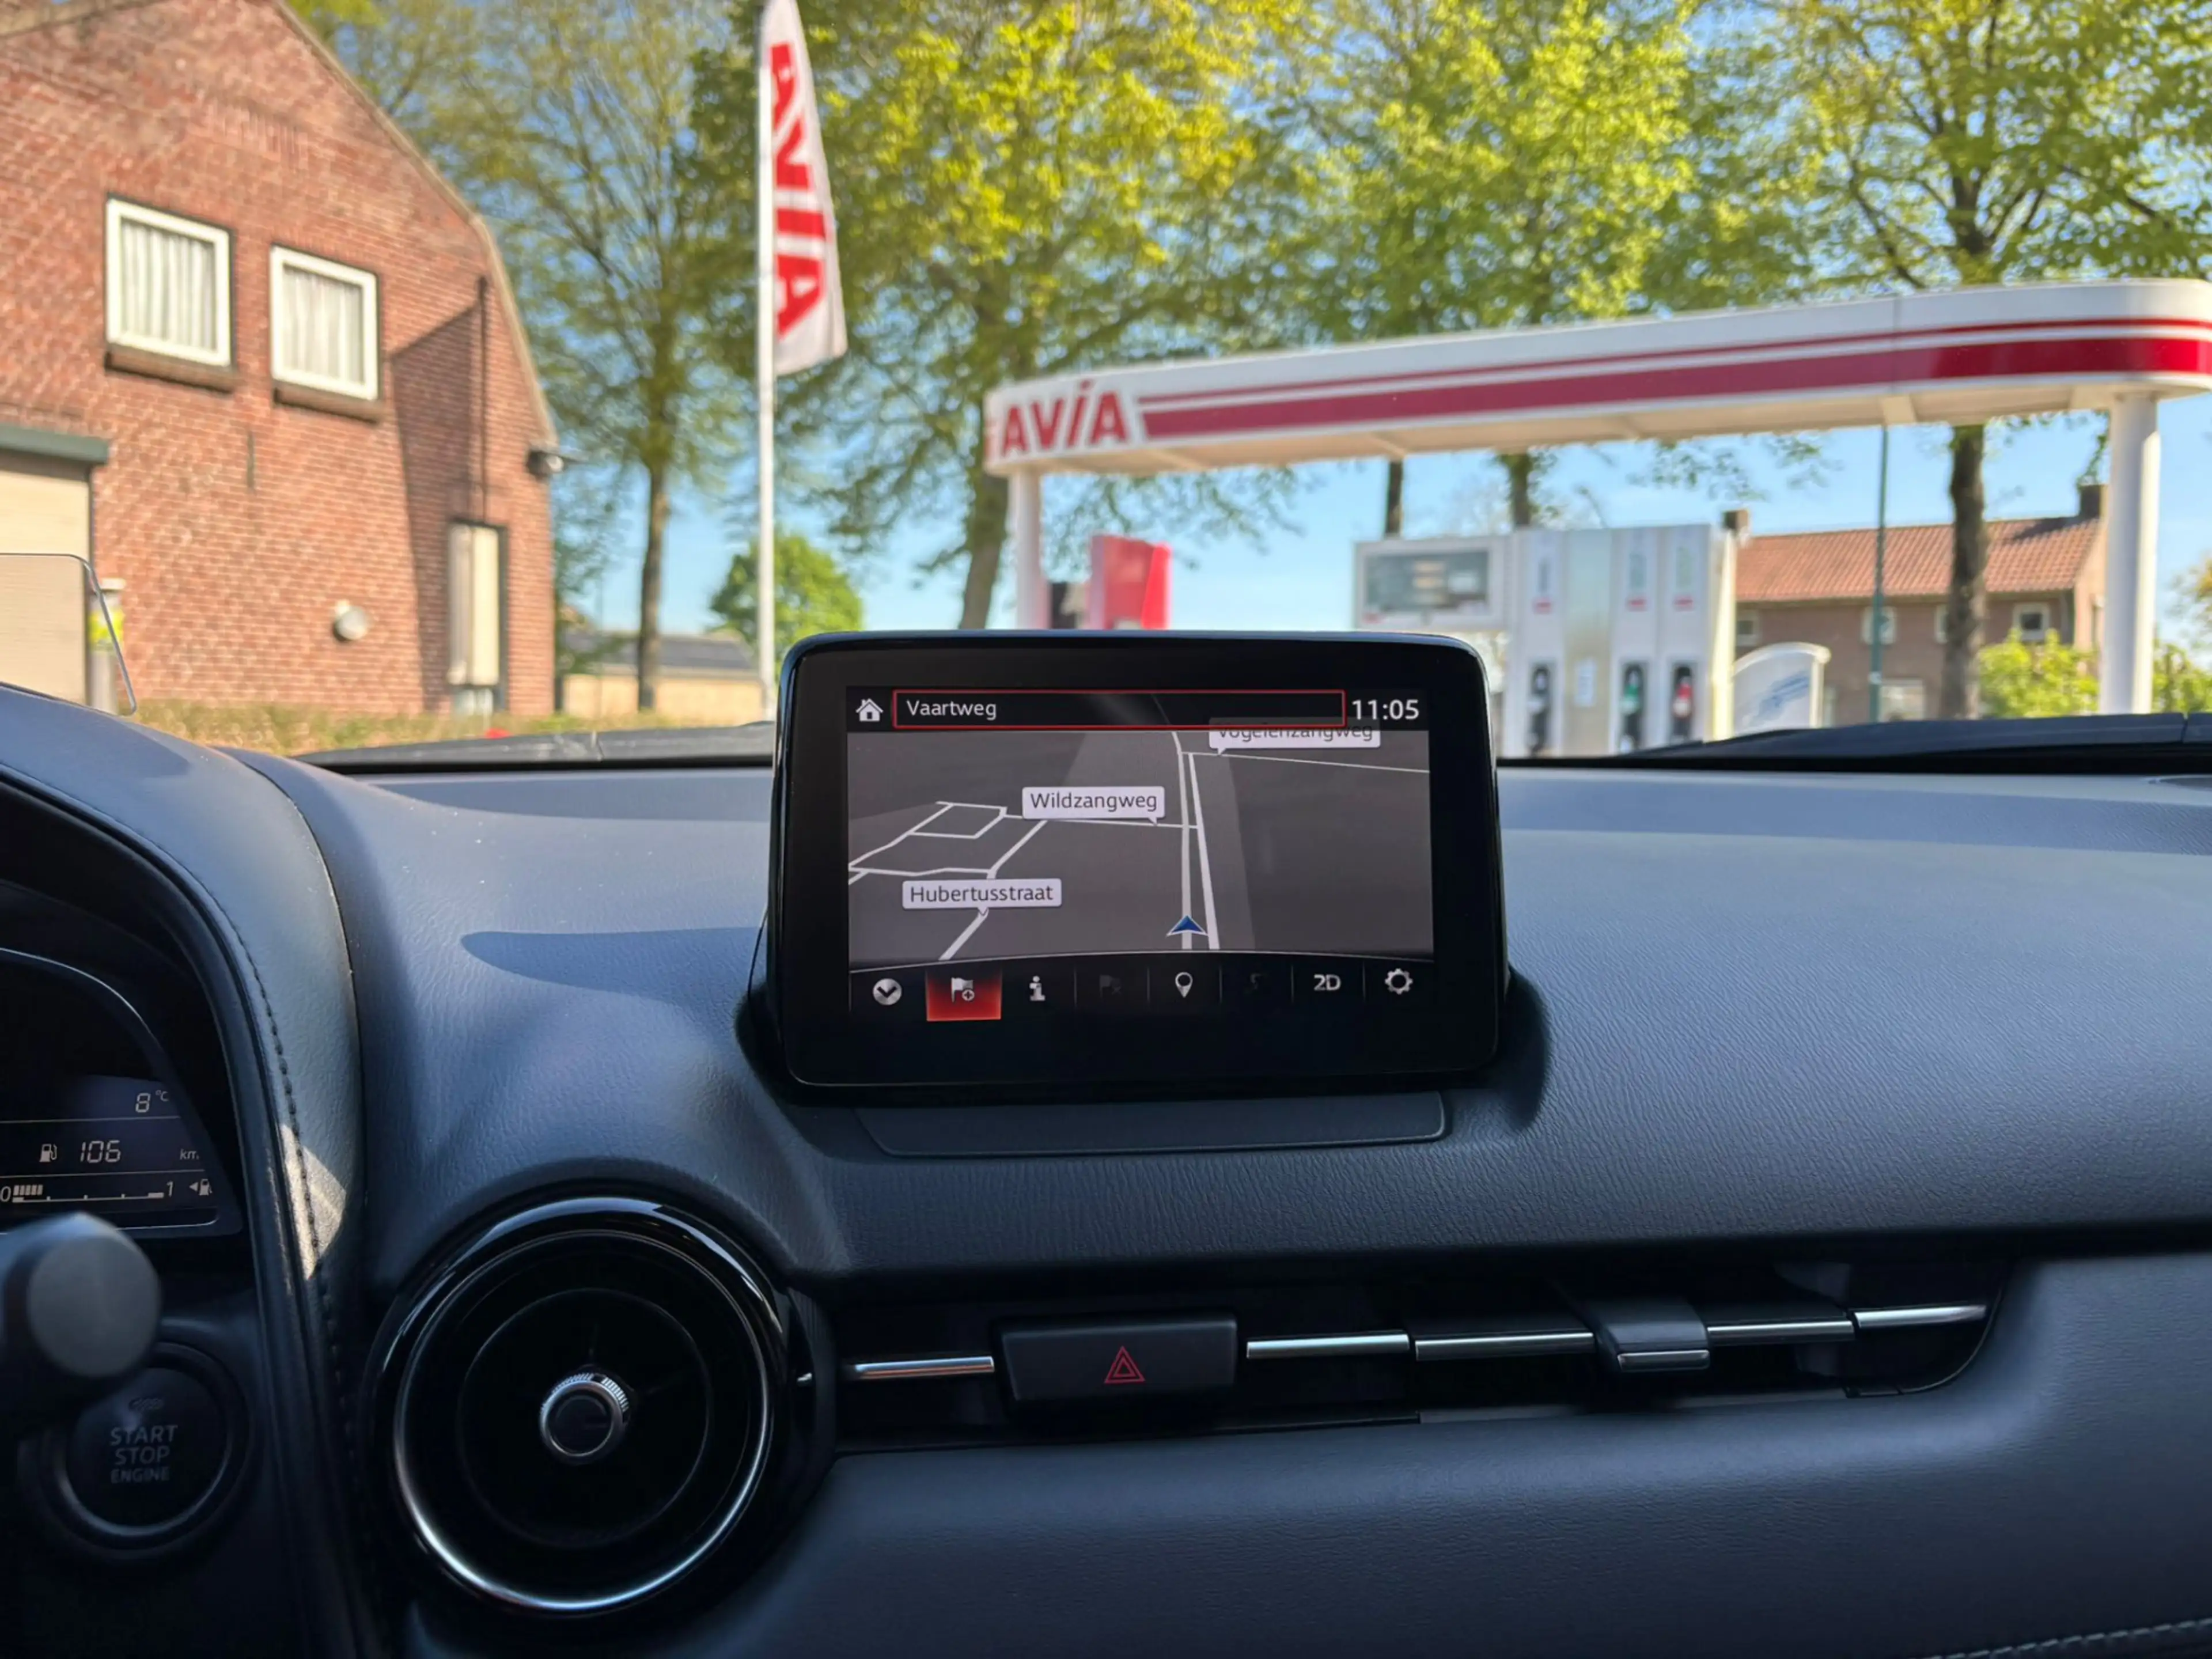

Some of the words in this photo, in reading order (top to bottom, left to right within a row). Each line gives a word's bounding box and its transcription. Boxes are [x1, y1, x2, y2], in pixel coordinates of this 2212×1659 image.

[906, 699, 997, 720] Vaartweg
[1352, 699, 1419, 720] 11:05
[1030, 793, 1157, 812] Wildzangweg
[910, 885, 1054, 903] Hubertusstraat
[1313, 974, 1341, 991] 2D
[79, 1140, 122, 1163] 106
[111, 1425, 178, 1445] START
[115, 1445, 171, 1465] STOP
[110, 1466, 172, 1484] ENGINE
